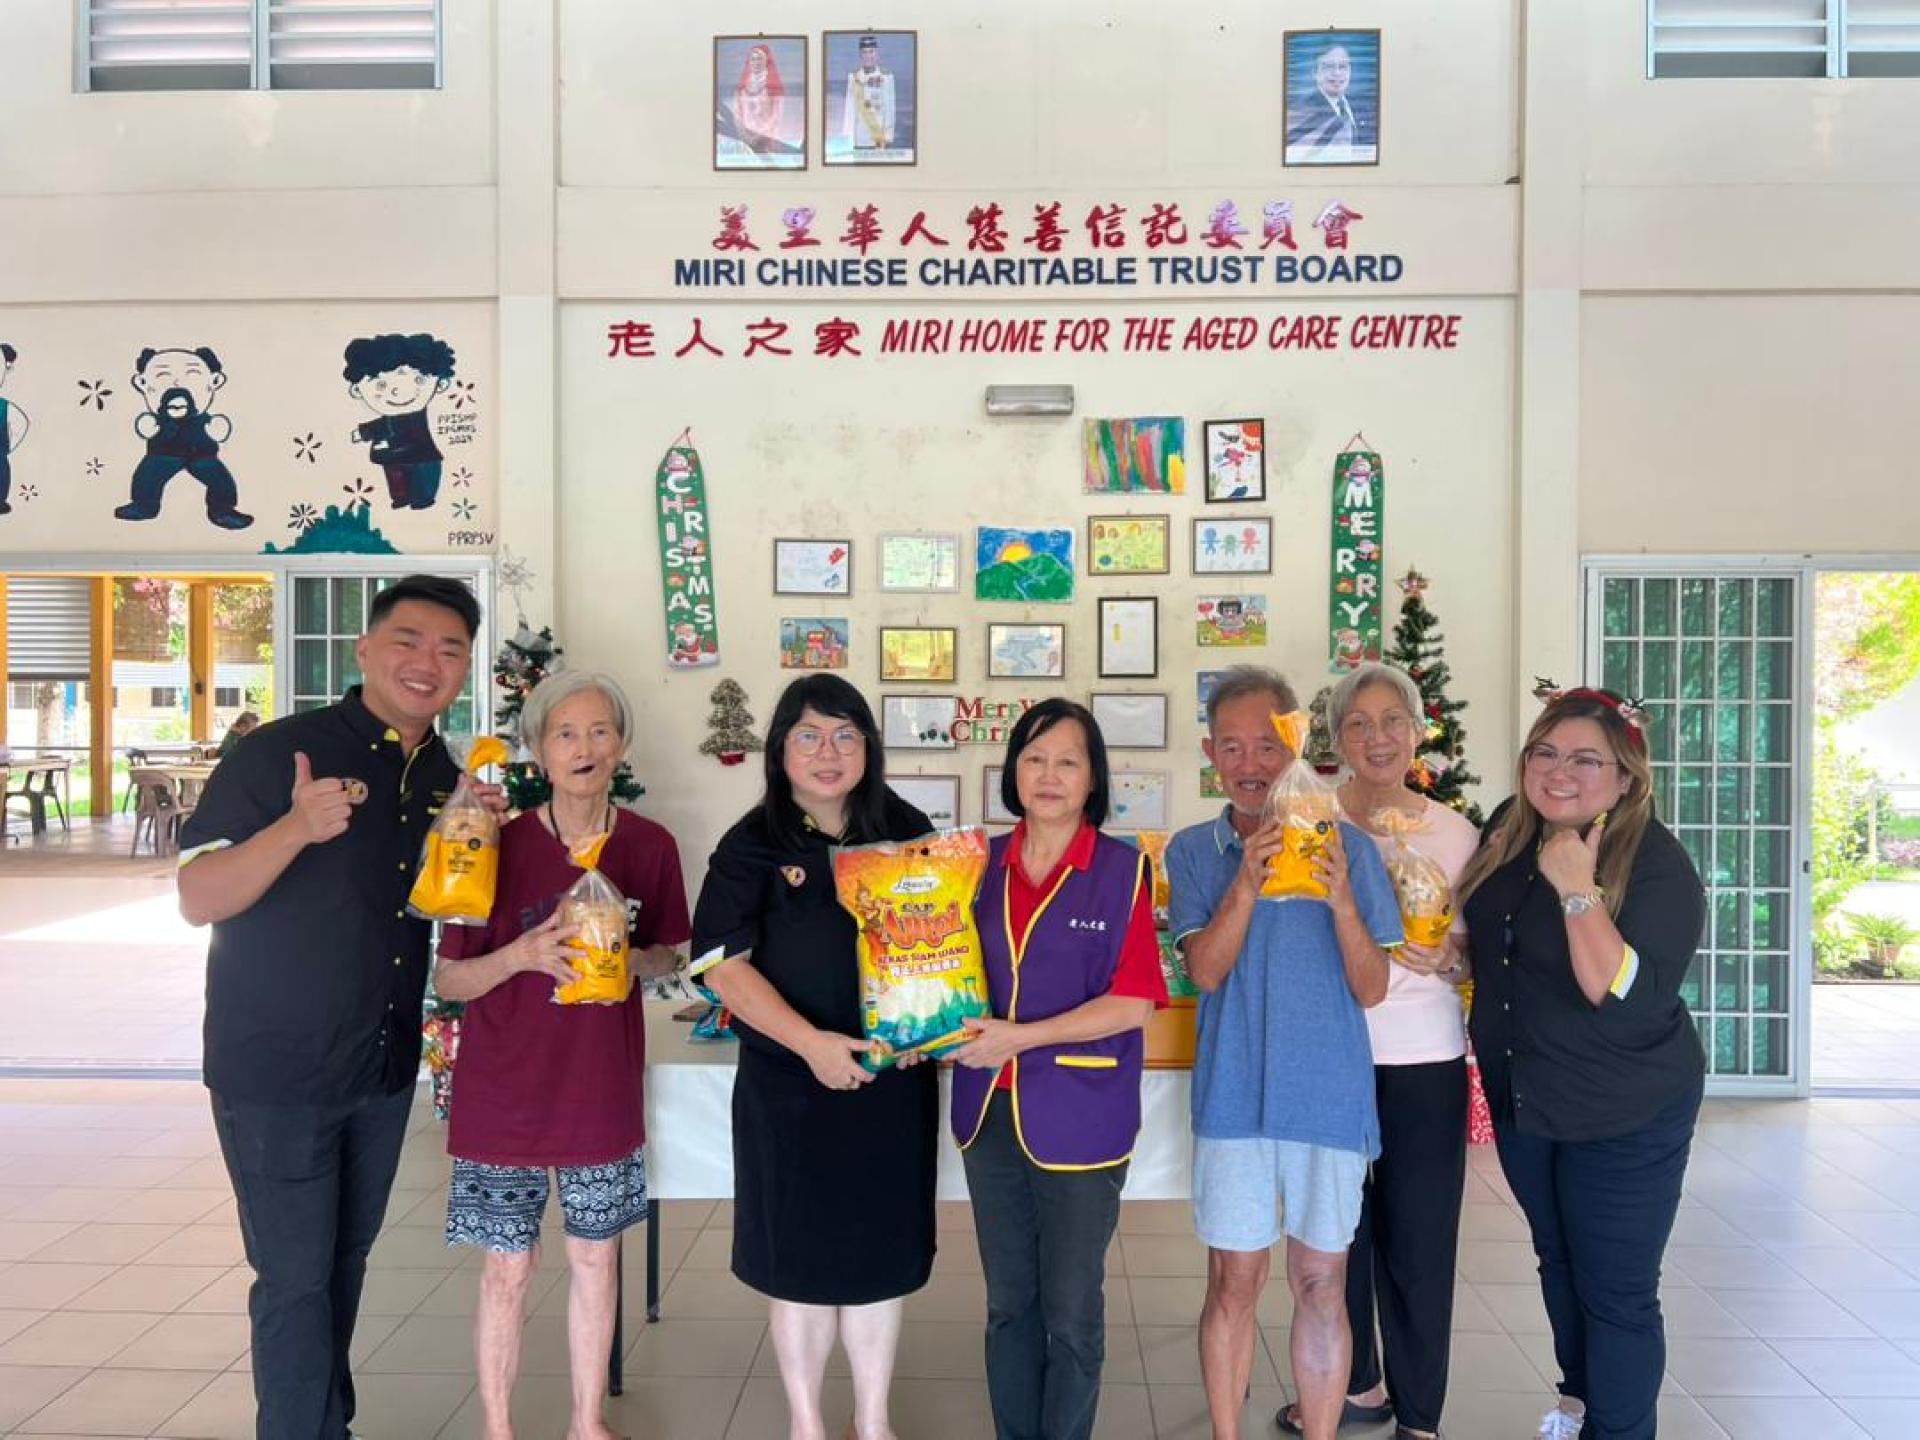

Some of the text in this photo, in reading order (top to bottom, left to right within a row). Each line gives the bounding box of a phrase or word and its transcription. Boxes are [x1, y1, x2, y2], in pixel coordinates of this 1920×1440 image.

[674, 254, 1404, 287] MIRI CHINESE CHARITABLE TRUST BOARD
[607, 317, 863, 358] 老人之家
[880, 314, 1462, 355] MIRI HOME FOR THE AGED CARE CENTRE
[1336, 480, 1377, 627] MERRY
[950, 720, 1009, 742] Chri
